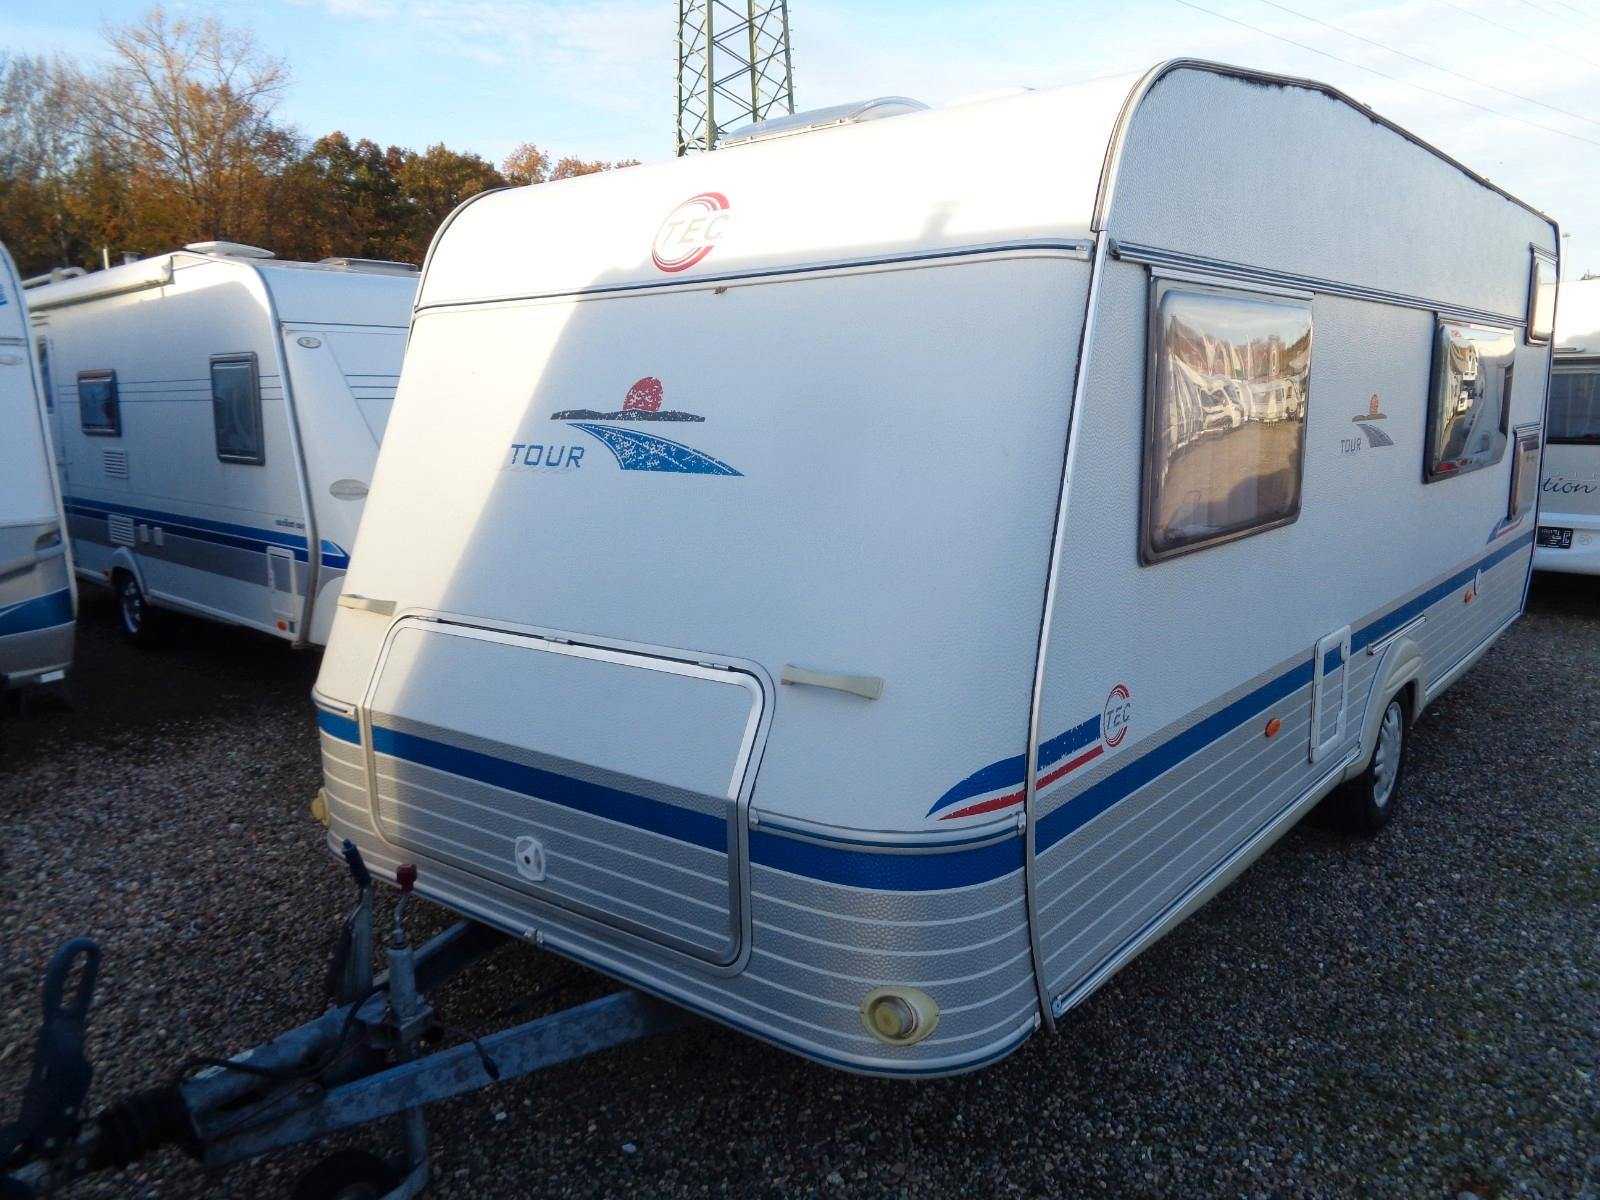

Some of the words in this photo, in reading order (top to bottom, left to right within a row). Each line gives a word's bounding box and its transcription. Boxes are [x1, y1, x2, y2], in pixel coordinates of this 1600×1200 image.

[661, 213, 731, 247] TEC
[511, 443, 585, 468] TOUR
[1340, 437, 1362, 454] TOUR
[1106, 703, 1131, 731] TEC
